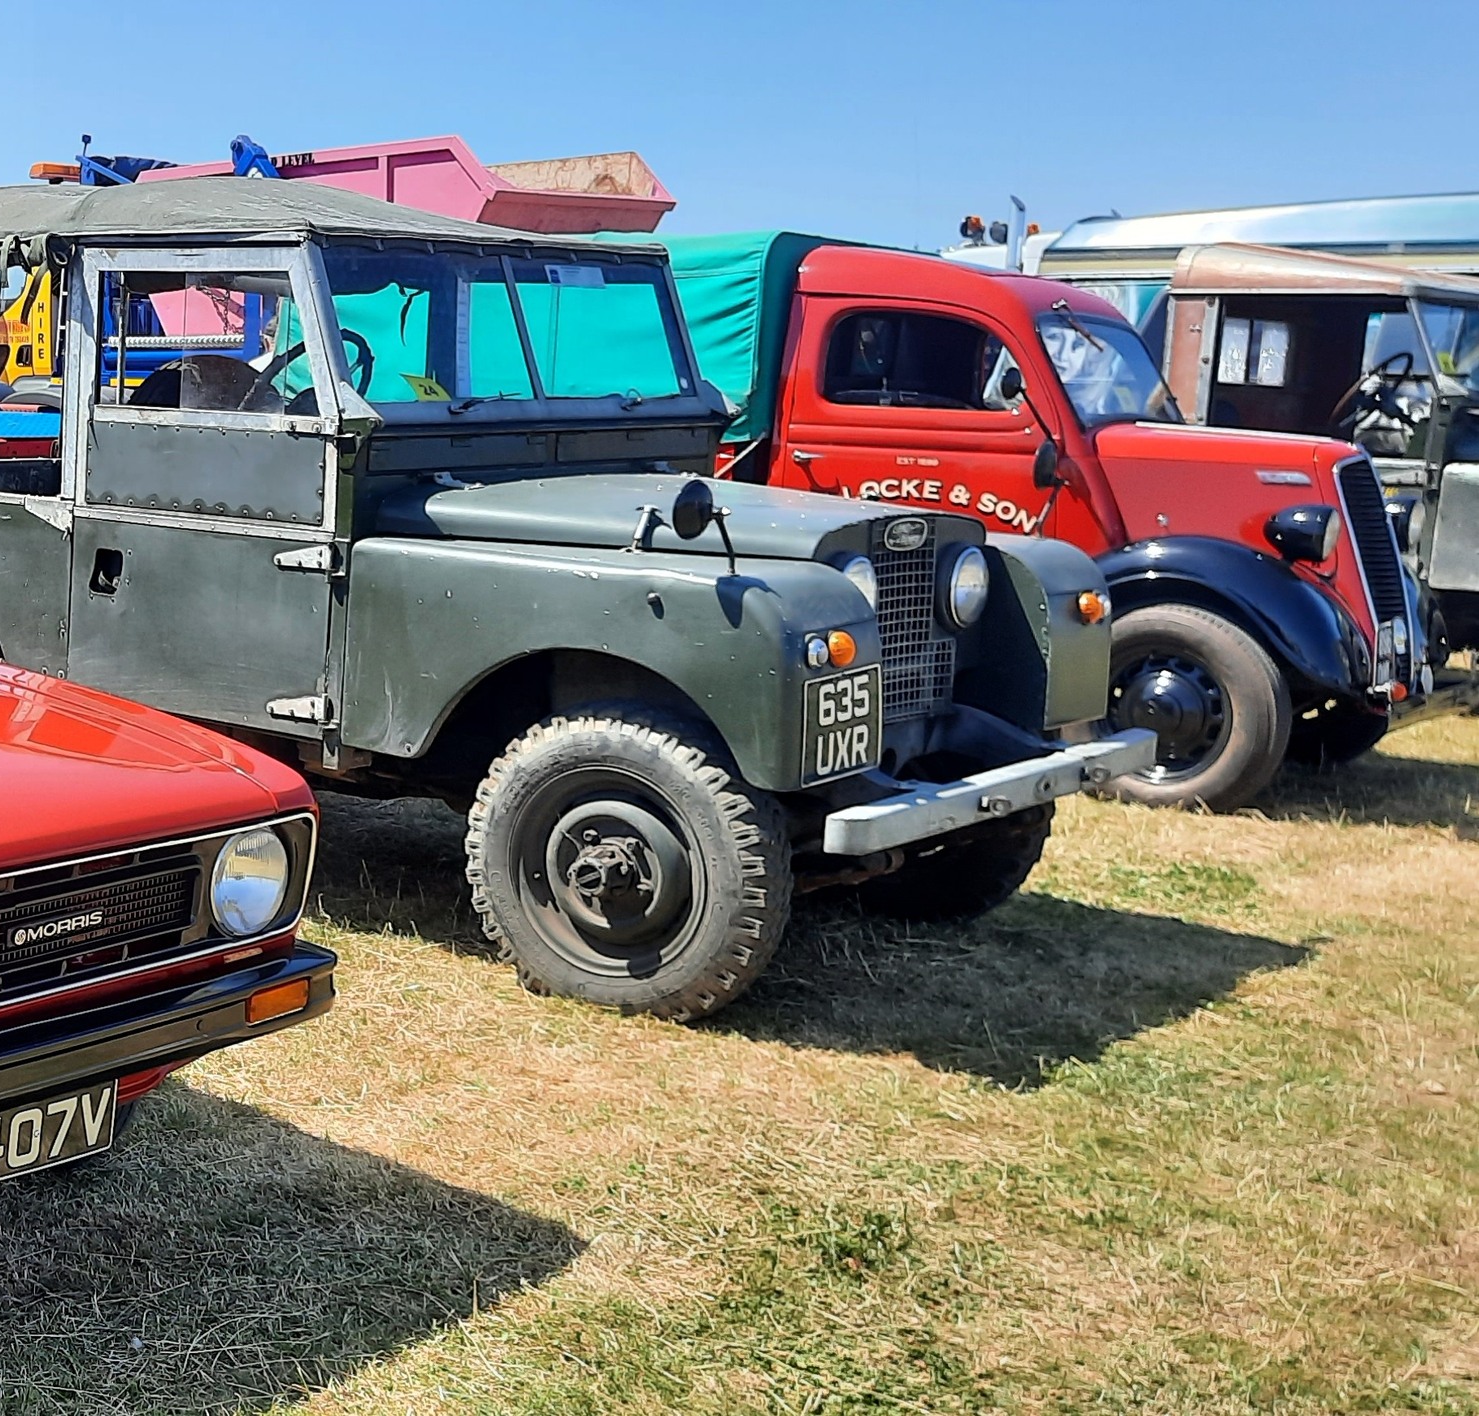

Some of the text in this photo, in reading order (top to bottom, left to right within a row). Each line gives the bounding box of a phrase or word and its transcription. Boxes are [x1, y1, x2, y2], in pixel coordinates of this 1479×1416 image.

[282, 153, 314, 168] LEVEL
[841, 478, 1037, 533] LOCKE & SON
[818, 673, 870, 727] 635
[816, 723, 869, 776] UXR
[27, 911, 103, 941] MORRIS
